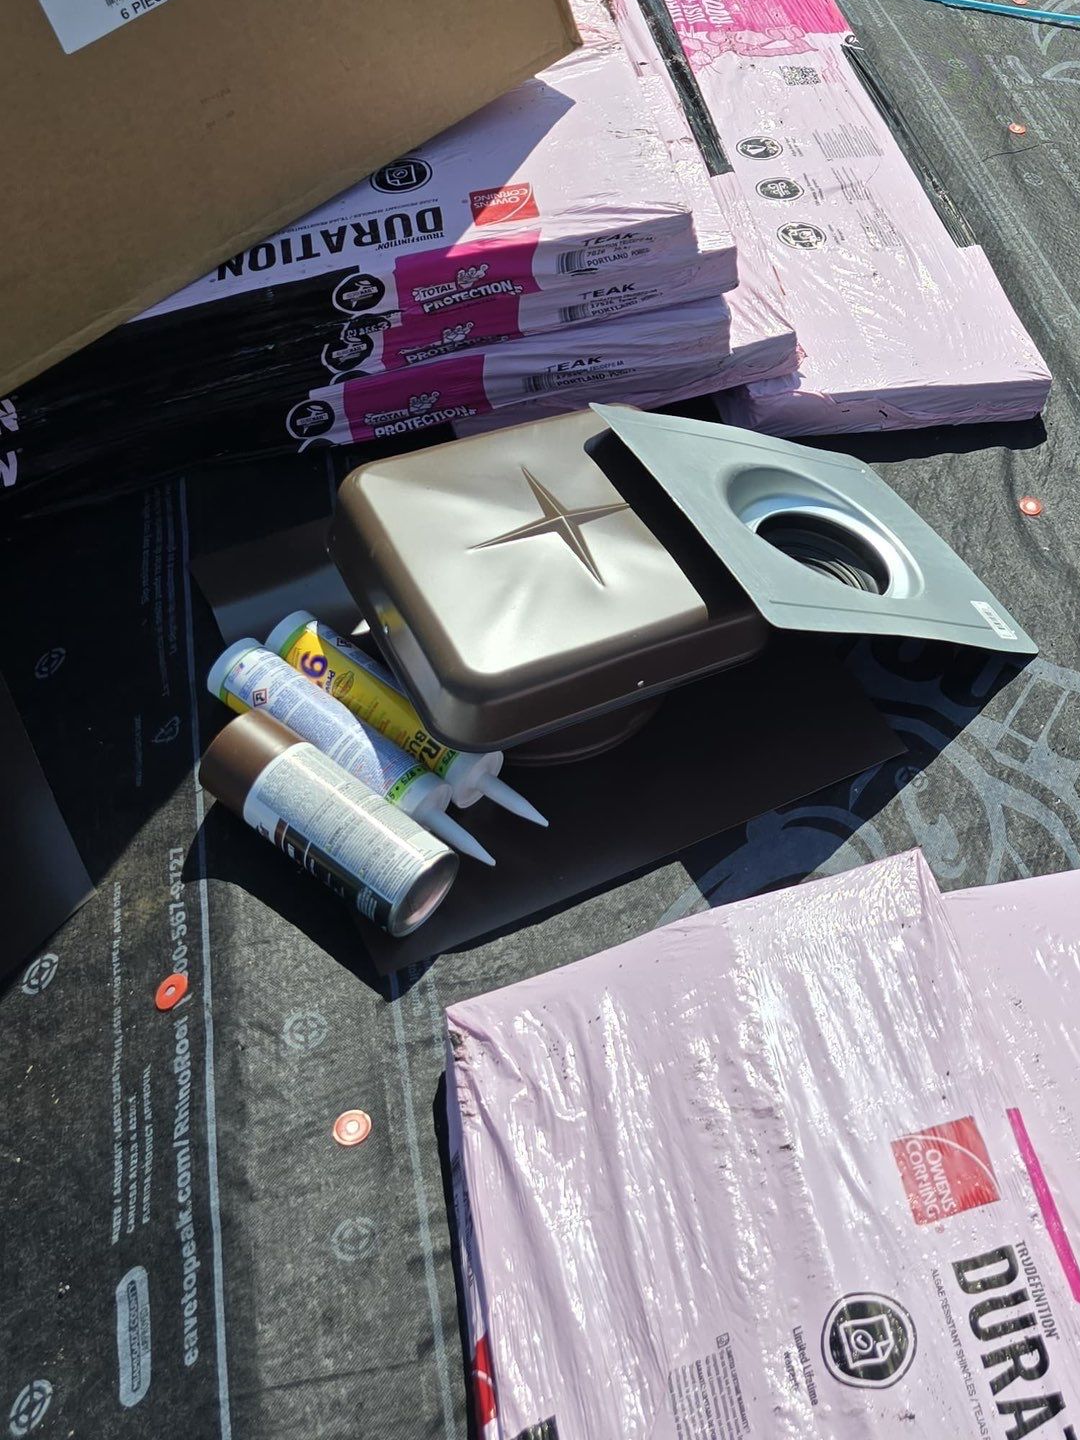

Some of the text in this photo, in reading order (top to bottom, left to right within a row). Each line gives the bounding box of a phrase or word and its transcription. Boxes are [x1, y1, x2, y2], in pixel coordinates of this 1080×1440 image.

[118, 6, 131, 20] 6
[473, 187, 528, 202] CORNING
[473, 195, 519, 208] OWENS
[210, 209, 445, 279] DURATION
[421, 282, 454, 297] TOTAL
[421, 280, 514, 314] PROTECTION
[576, 282, 636, 300] TEAK
[544, 355, 602, 373] TEAK
[373, 405, 470, 438] PROTECTION
[168, 846, 189, 976] 00-567-9727
[141, 1063, 154, 1120] APPROVAL
[141, 1174, 151, 1224] FLORIDA
[903, 1137, 941, 1219] CORNING
[923, 1145, 957, 1213] OWENS
[1014, 1239, 1060, 1341] TRUDEFINITION
[792, 1325, 821, 1406] Limited Lifetime
[929, 1267, 945, 1296] ALGAE
[938, 1298, 961, 1348] RESISTANT
[954, 1348, 976, 1396] SHINGLES
[971, 1403, 989, 1435] TEJAS
